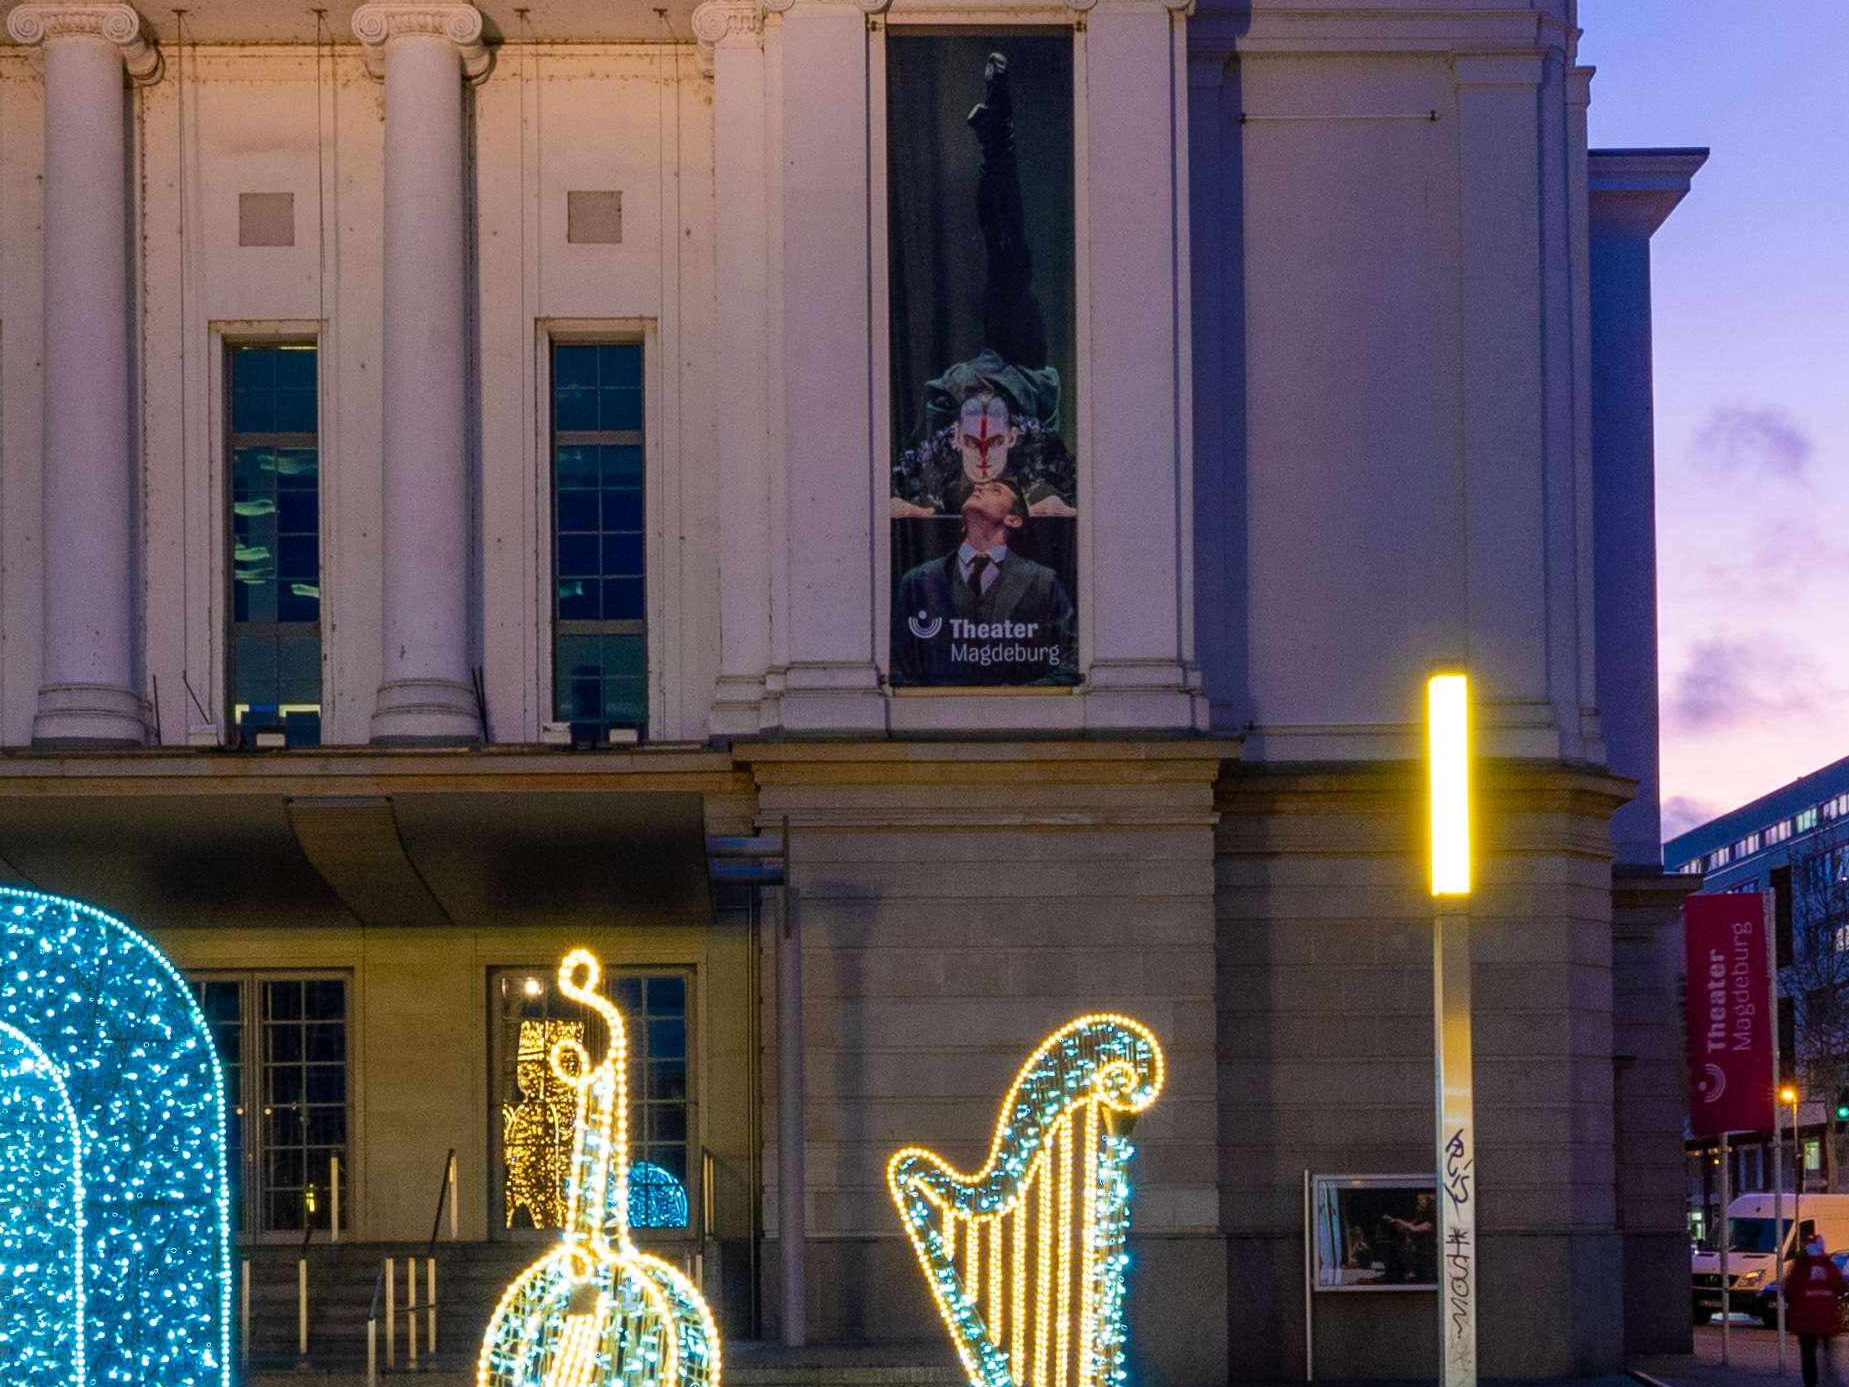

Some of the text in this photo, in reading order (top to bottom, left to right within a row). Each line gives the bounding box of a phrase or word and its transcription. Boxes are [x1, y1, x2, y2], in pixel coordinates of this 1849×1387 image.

[950, 619, 1038, 638] Theater
[951, 643, 1060, 665] Magdeburg
[1707, 948, 1727, 1054] Theater
[1731, 921, 1756, 1051] Magdeburg
